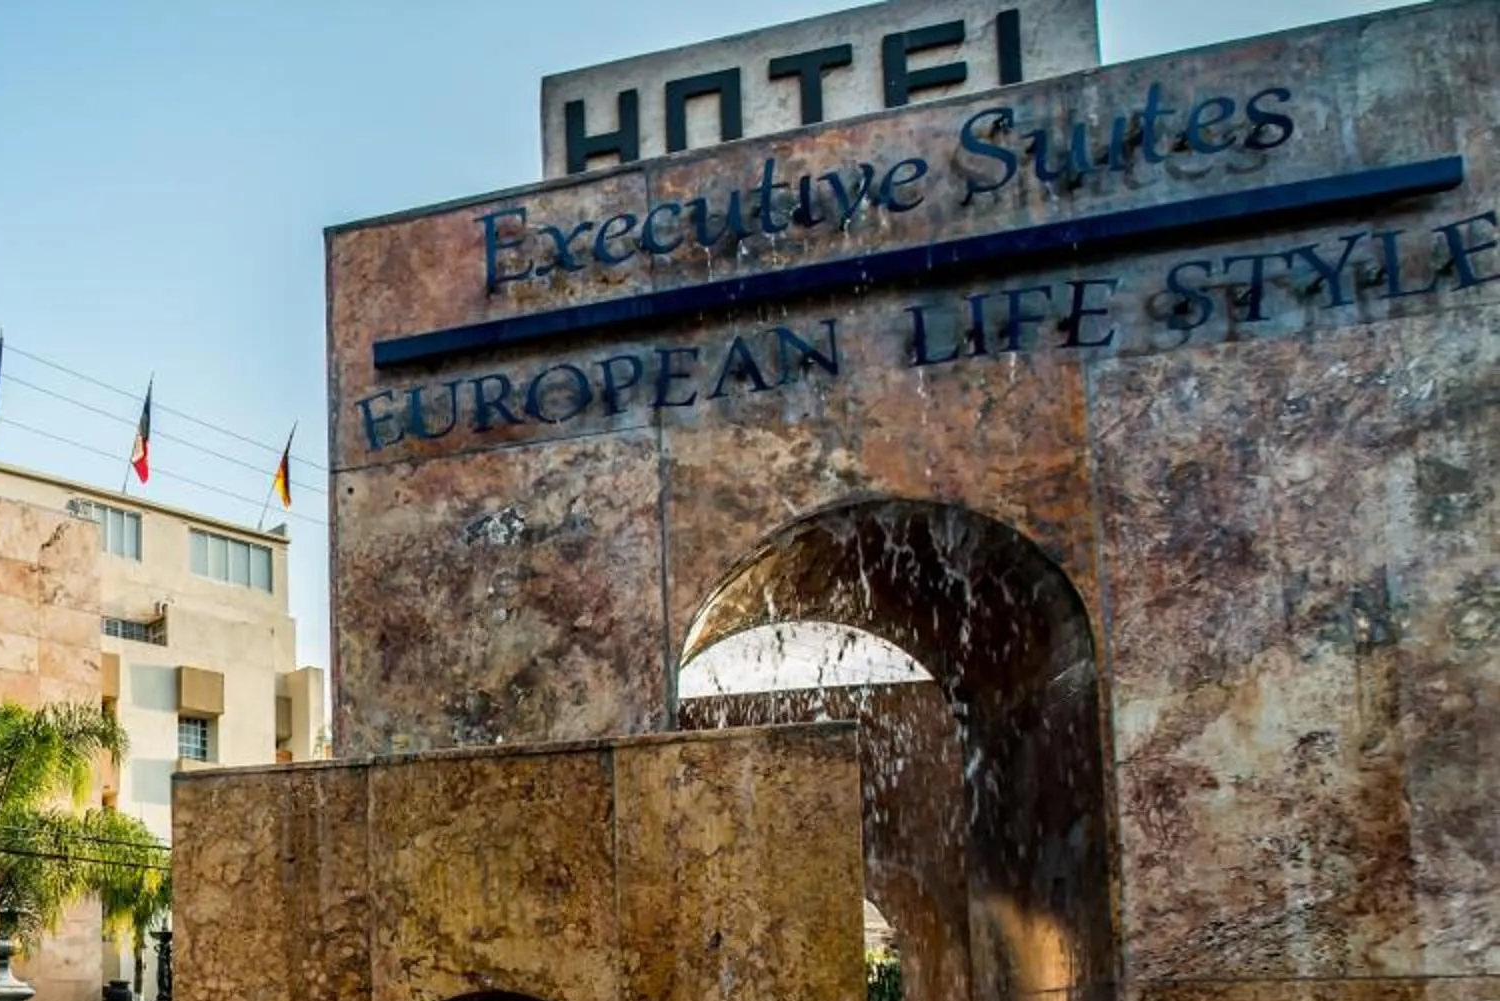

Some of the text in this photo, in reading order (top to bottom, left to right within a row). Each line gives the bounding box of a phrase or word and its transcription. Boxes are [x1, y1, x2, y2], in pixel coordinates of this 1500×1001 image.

[474, 83, 1295, 296] Executive Suites
[356, 211, 1500, 453] EUROPEAN LIFE STYLE
